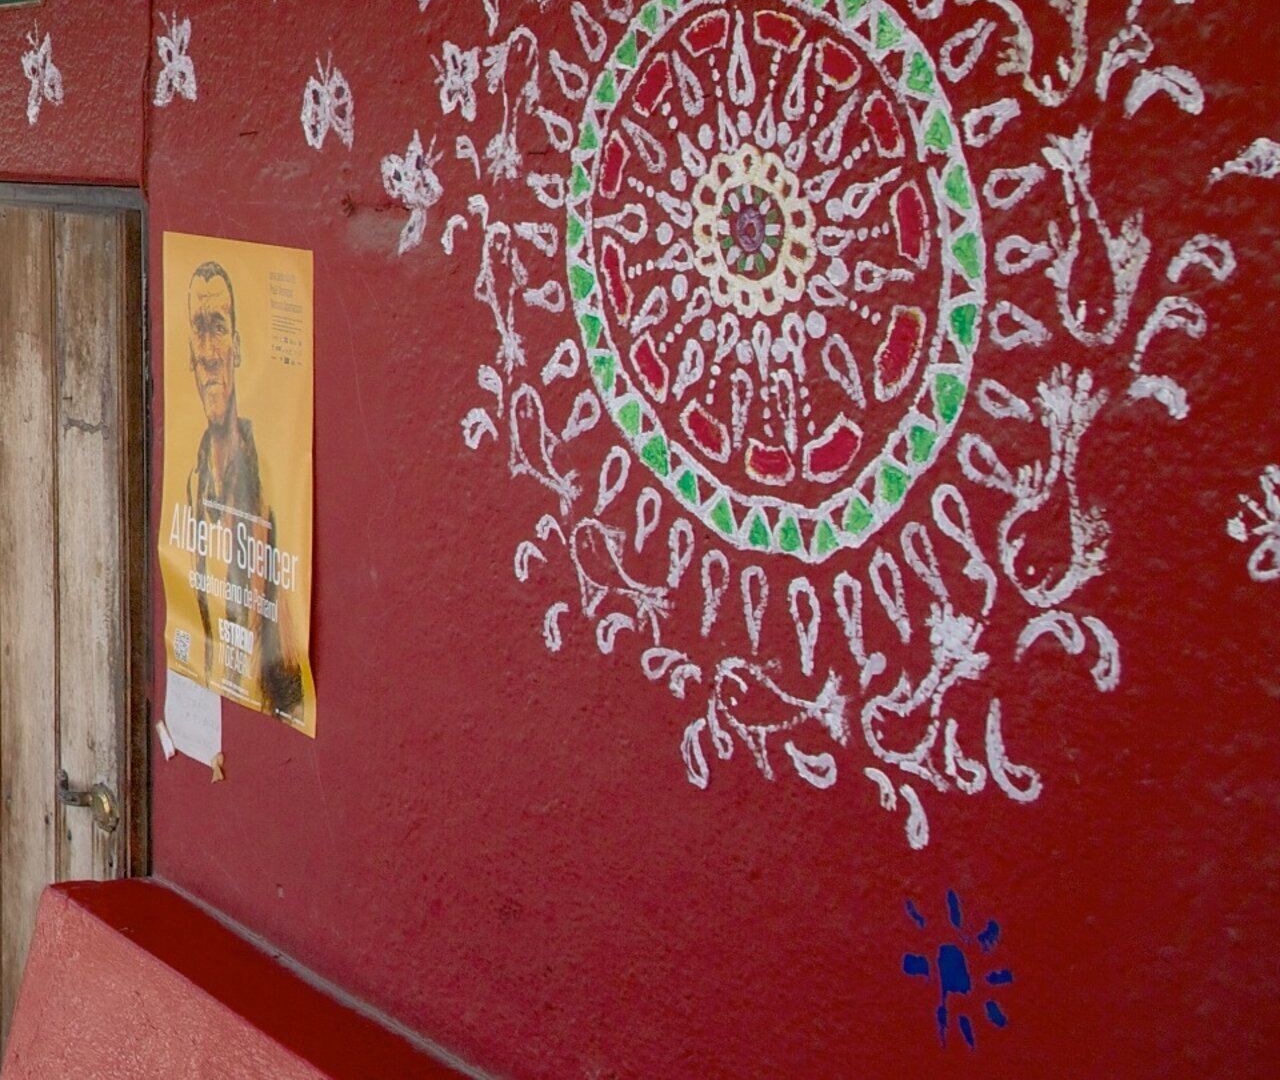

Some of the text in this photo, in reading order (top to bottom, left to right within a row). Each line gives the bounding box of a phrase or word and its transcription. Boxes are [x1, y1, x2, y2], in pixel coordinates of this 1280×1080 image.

[169, 503, 234, 565] Alberto
[236, 521, 298, 592] Spencer
[188, 570, 242, 605] ecuatoriano
